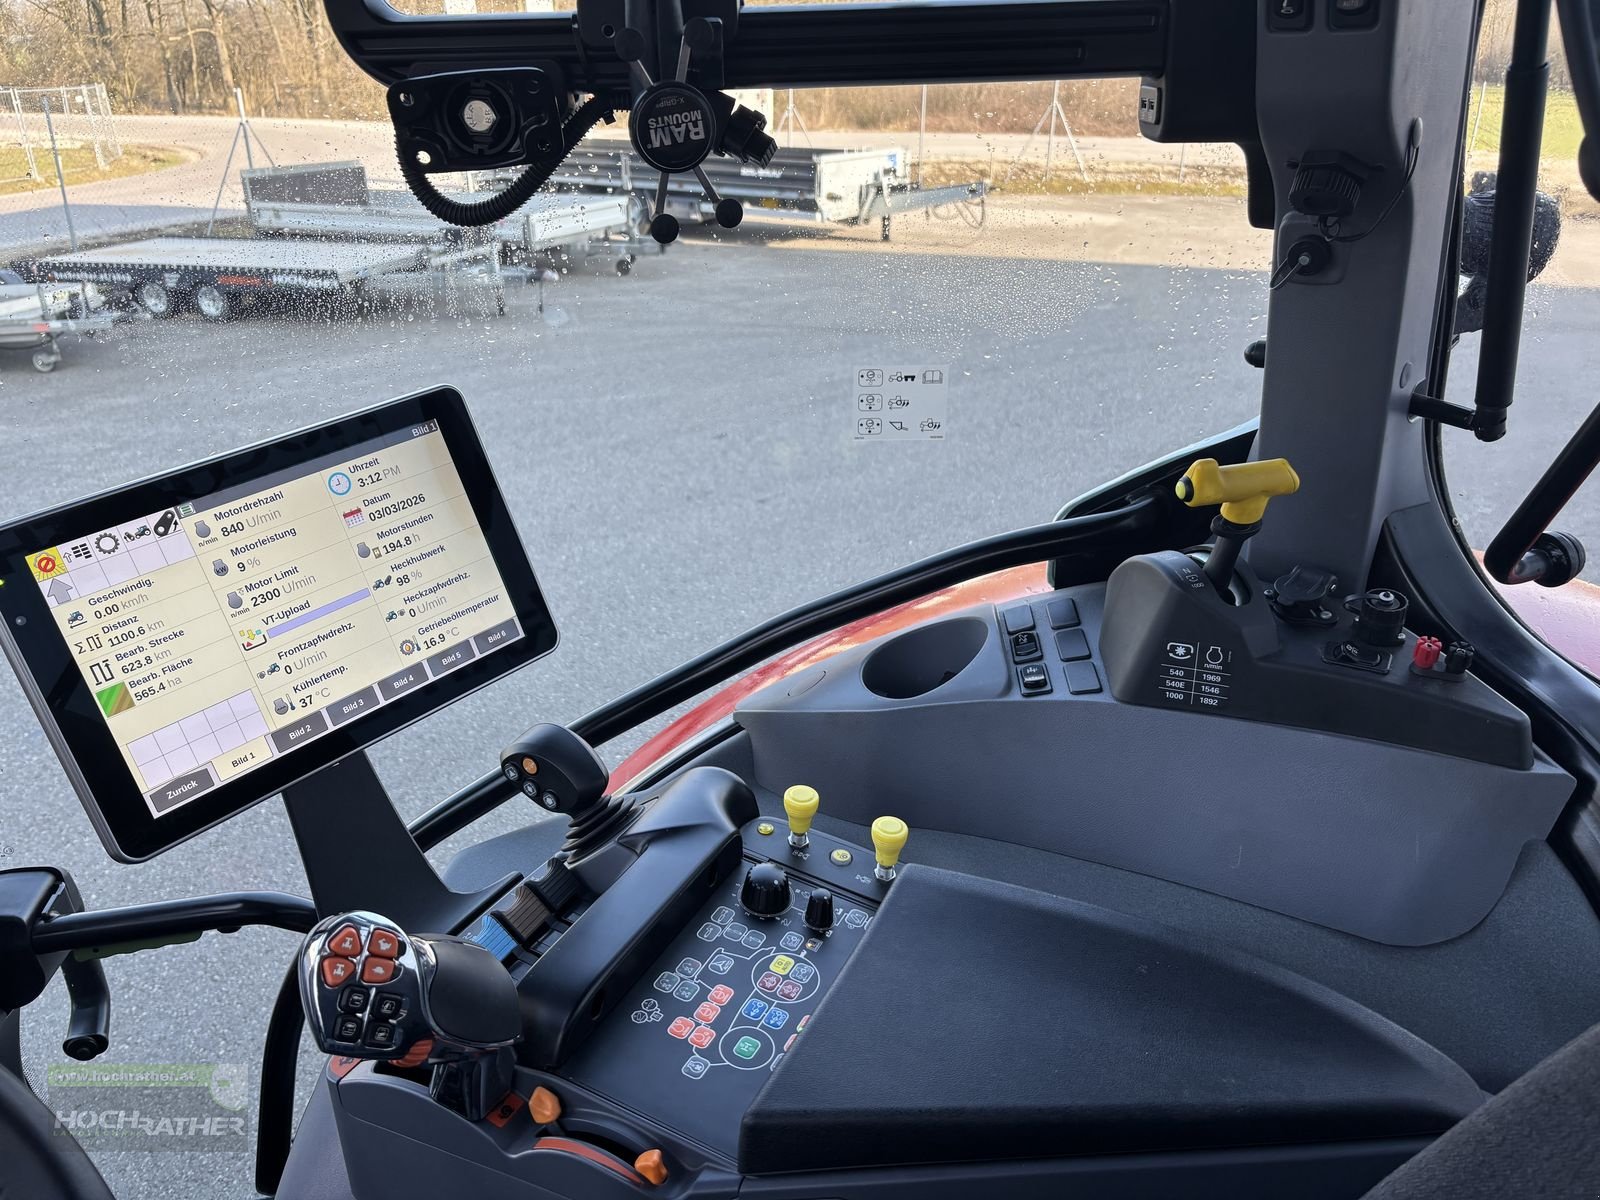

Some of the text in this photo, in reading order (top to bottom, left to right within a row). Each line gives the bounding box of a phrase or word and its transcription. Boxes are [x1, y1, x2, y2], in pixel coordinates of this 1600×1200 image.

[648, 110, 702, 128] MOUNTS
[649, 120, 705, 148] RAM
[412, 424, 429, 436] Bild
[348, 457, 380, 474] Uhrzeit
[357, 465, 401, 488] 3:12 PM
[214, 491, 284, 522] Motordrehzahl
[362, 492, 390, 508] Datum
[368, 494, 426, 522] 03/03/2026
[221, 509, 282, 537] 840 U/min
[376, 512, 434, 540] Motorstunden
[198, 536, 218, 548] n/min
[230, 527, 297, 557] Motorleistung
[382, 533, 420, 556] 194.8 h
[237, 556, 261, 572] 9 %
[390, 544, 446, 572] Heckhubwerk
[244, 566, 299, 593] Motor Limit
[396, 570, 422, 586] 98 %
[403, 572, 471, 605] Heckzapfwdrehz.
[88, 578, 154, 606] Geschwindig.
[250, 575, 316, 608] 2300 U/min
[94, 593, 149, 620] 0.00 km/h
[230, 607, 250, 618] n/min
[262, 600, 311, 626] VT-Upload
[408, 596, 448, 618] 0 U/min
[418, 594, 500, 637] Getriebeöltemperatur
[102, 614, 139, 635] Distanz
[108, 620, 165, 648] 1100.6 km
[114, 629, 185, 662] Bearb. Strecke
[278, 622, 356, 660] Frontzapfwdrehz.
[424, 626, 460, 650] 16.9 °C
[488, 631, 500, 644] Bild
[121, 648, 172, 674] 623.8 km
[284, 650, 328, 676] 0 U/min
[442, 654, 454, 666] Bild
[129, 657, 193, 690] Bearb. Fläche
[292, 664, 348, 694] Kühlertemp.
[394, 676, 407, 689] Bild
[1170, 668, 1184, 676] 540
[1202, 674, 1221, 682] 1969
[134, 675, 182, 702] 565.4 ha
[1166, 680, 1184, 688] 540E
[1201, 686, 1220, 694] 1546
[299, 687, 330, 708] 37 °C
[342, 700, 356, 714] Bild
[1166, 692, 1184, 700] 1000
[1200, 697, 1218, 706] 1892
[289, 726, 304, 740] Bild
[231, 754, 247, 768] Bild
[166, 780, 198, 800] Zurück
